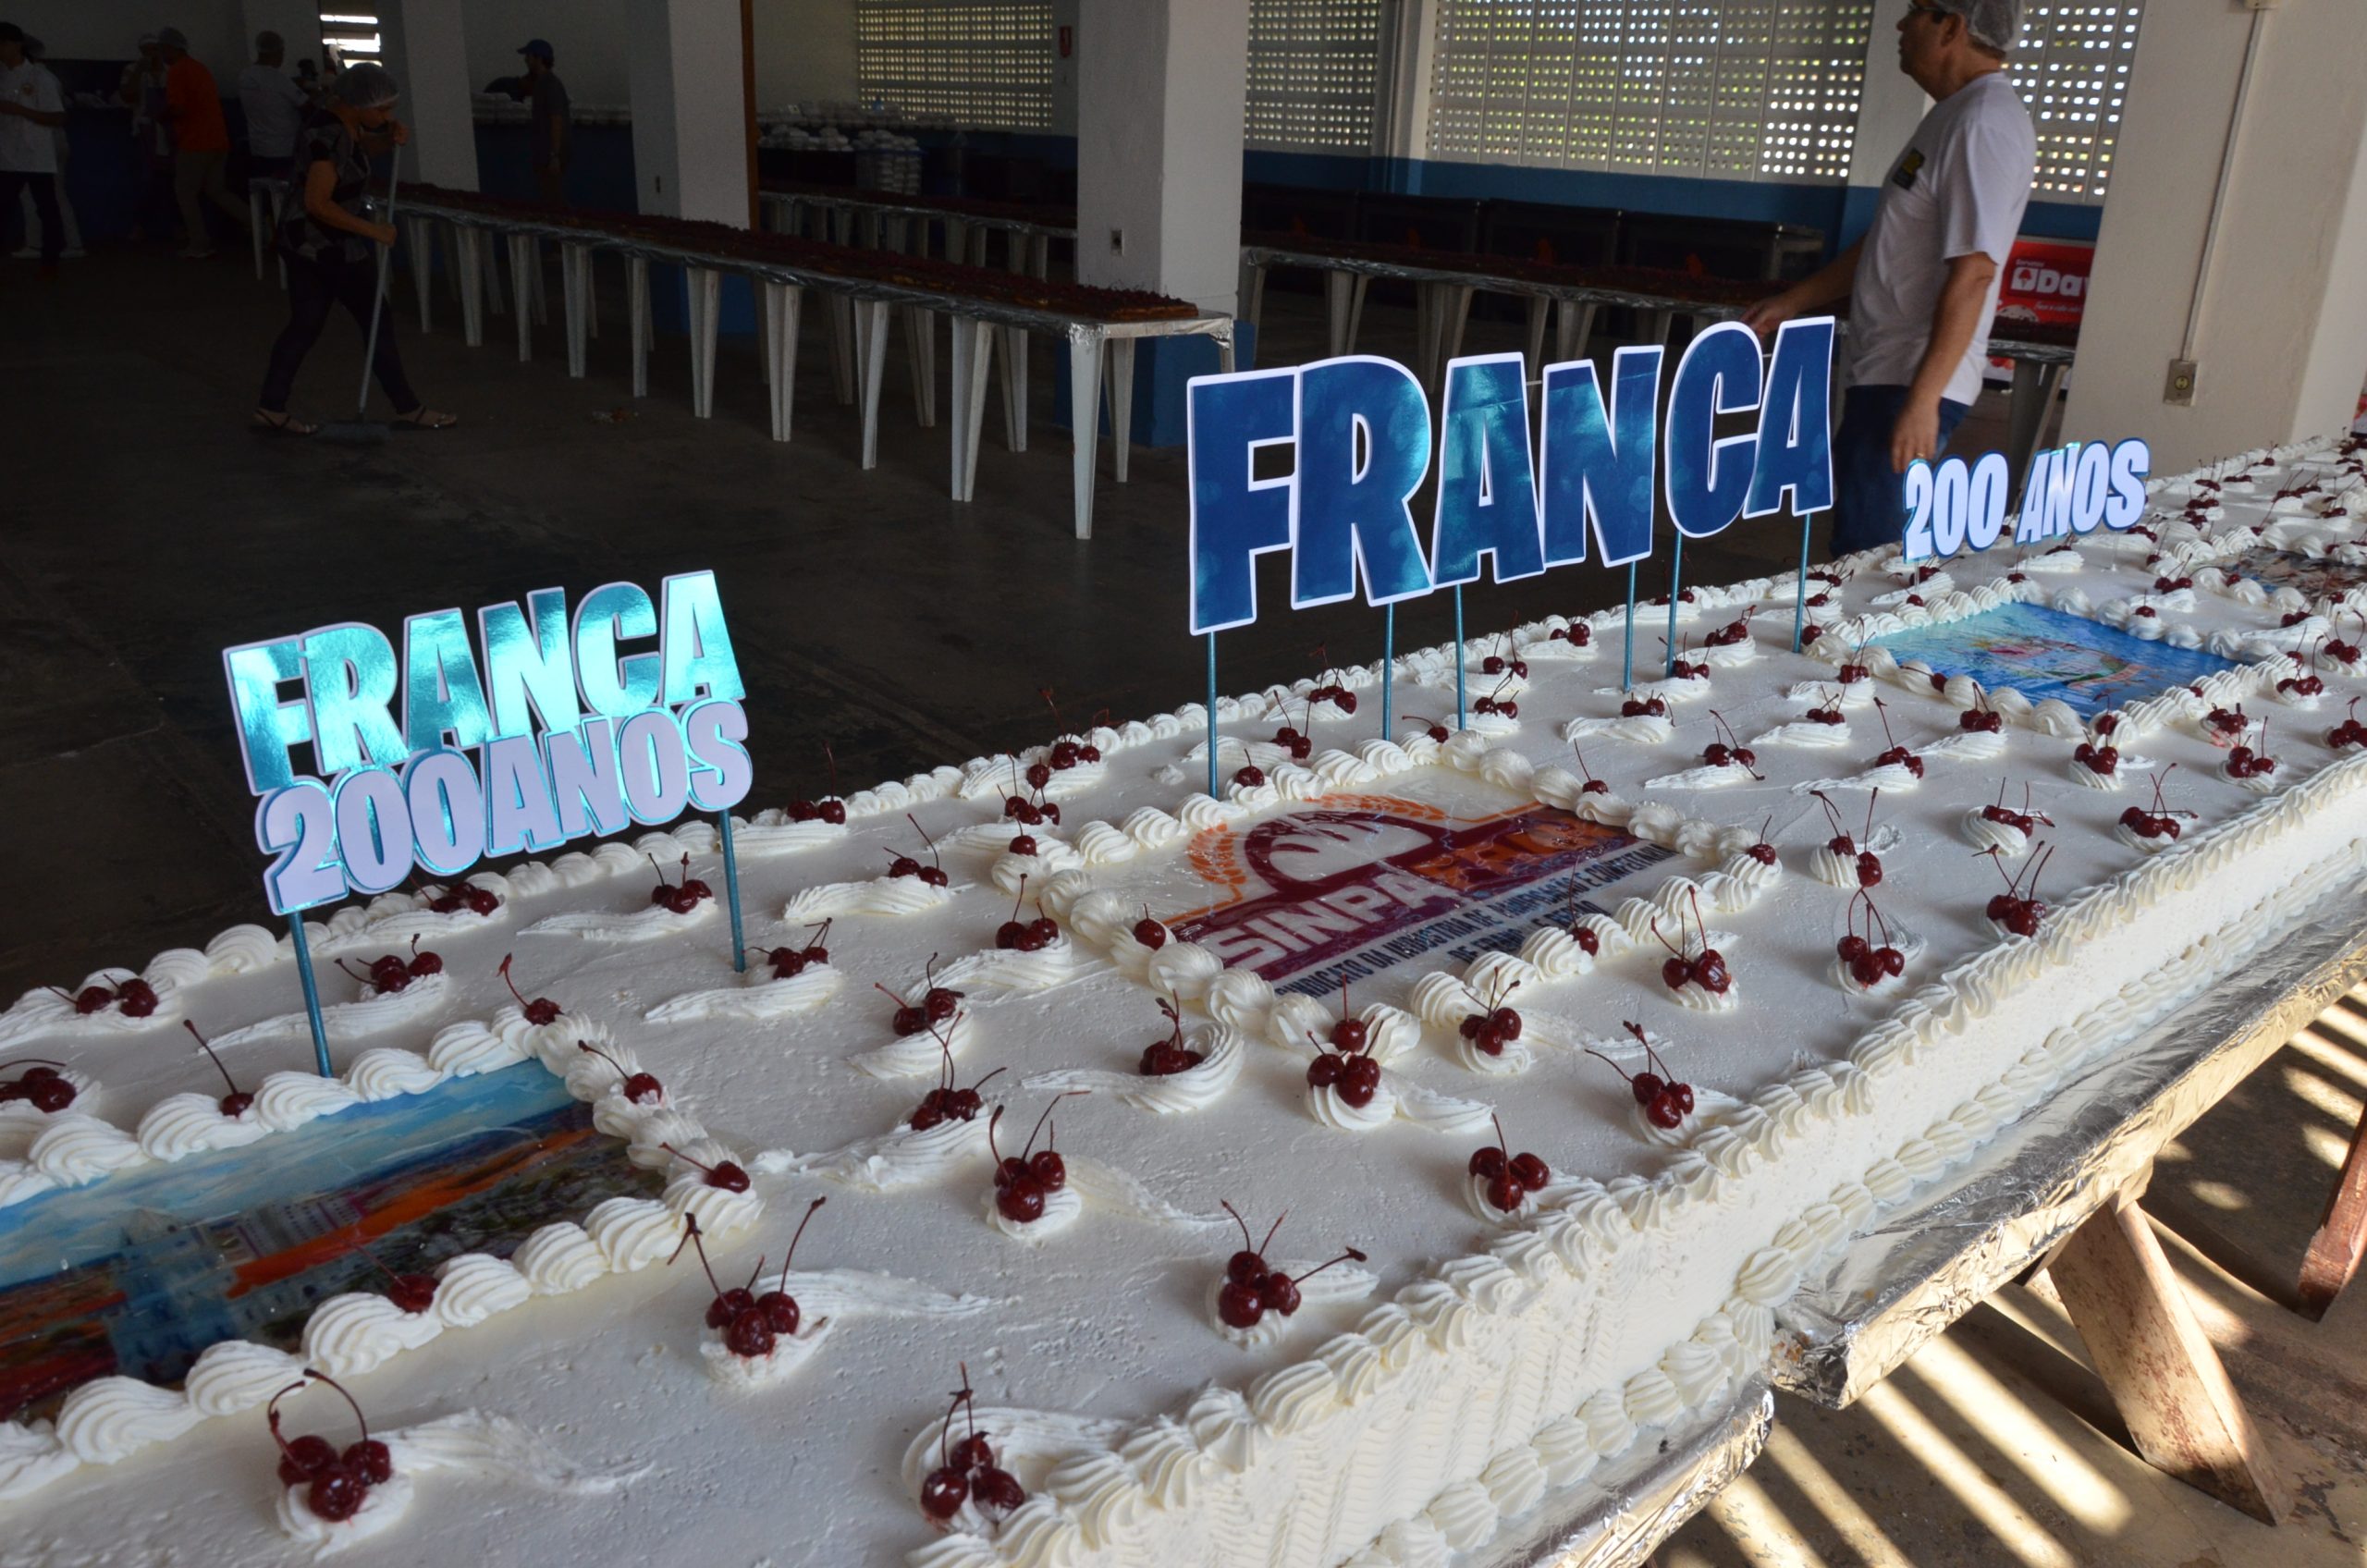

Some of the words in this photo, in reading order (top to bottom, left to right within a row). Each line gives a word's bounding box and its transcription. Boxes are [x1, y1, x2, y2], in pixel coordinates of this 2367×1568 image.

[2036, 267, 2089, 297] Da
[1187, 315, 1835, 636] FRANCA
[1903, 450, 2009, 563] 200
[2015, 437, 2151, 545] ANOS
[222, 570, 747, 796] FRANCA
[1356, 947, 1402, 976] DA
